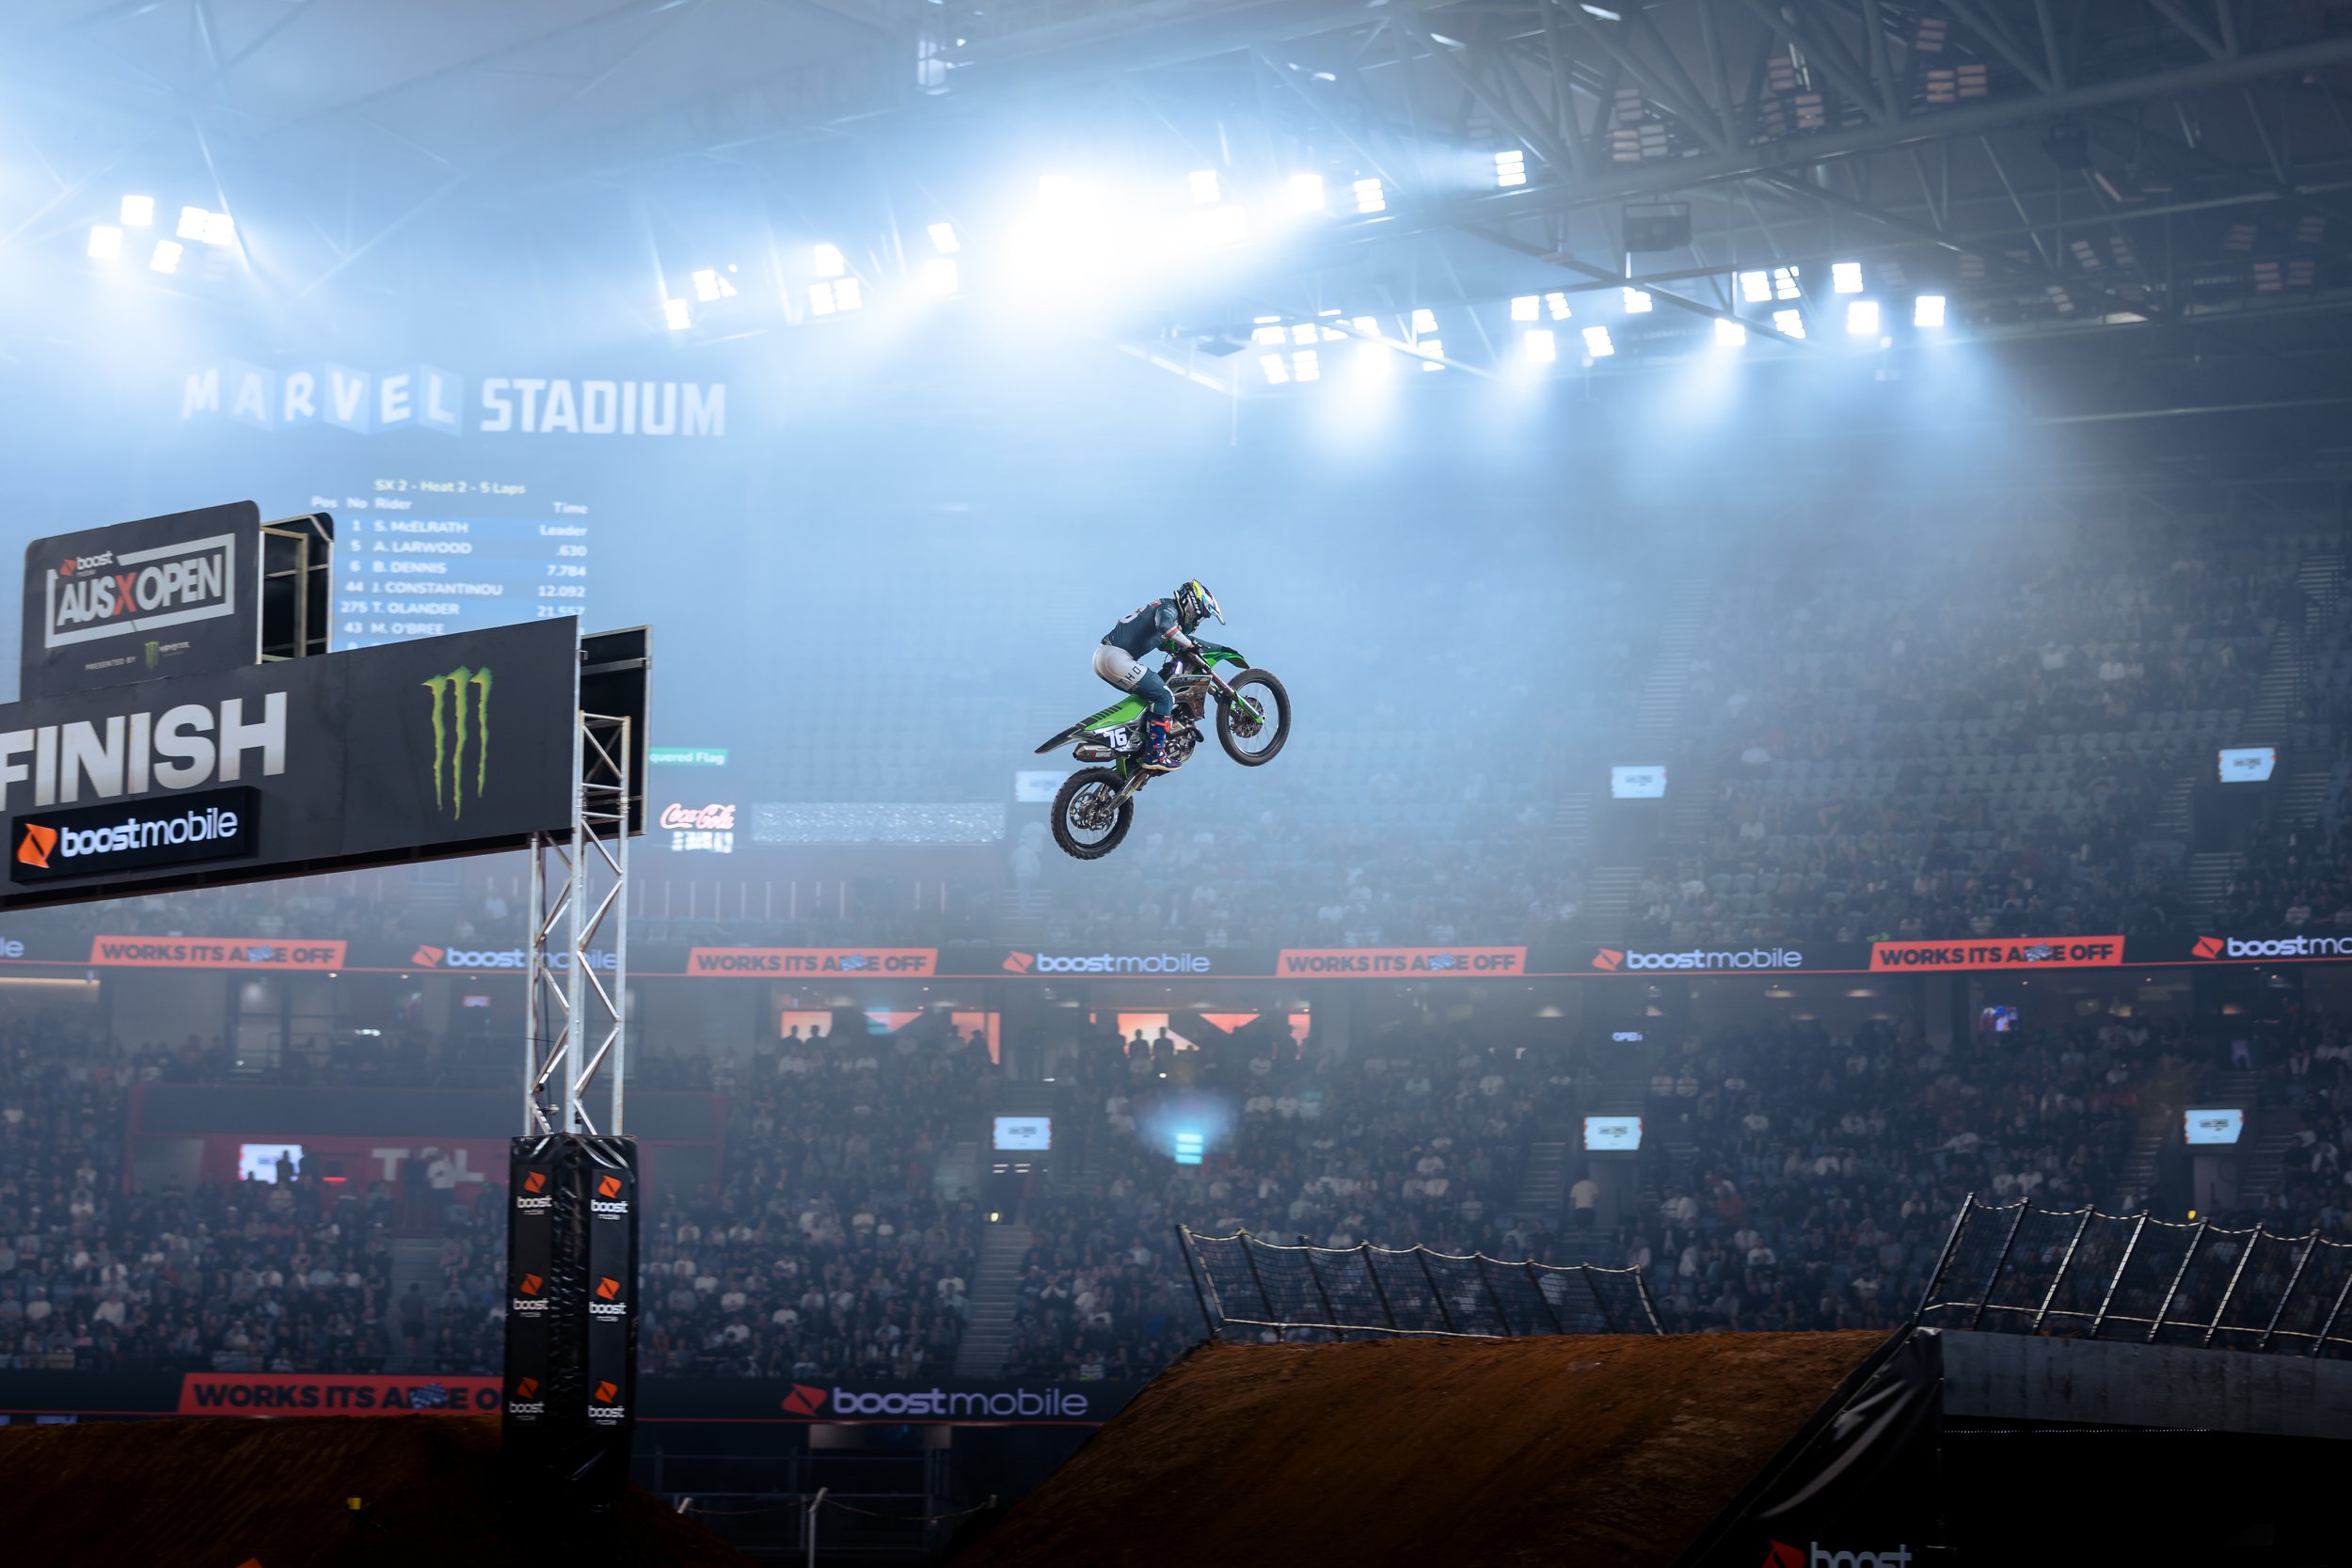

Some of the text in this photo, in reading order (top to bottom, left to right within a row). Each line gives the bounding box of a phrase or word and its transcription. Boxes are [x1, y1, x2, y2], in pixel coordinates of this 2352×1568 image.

[181, 368, 726, 436] MARVEL STADIUM
[374, 480, 395, 491] SX
[398, 481, 407, 492] 2
[421, 482, 454, 493] Heat
[457, 483, 467, 493] 2
[480, 483, 489, 494] 5
[493, 483, 526, 496] Laps
[311, 497, 588, 515] Pos No Rider Time
[352, 520, 360, 531] 1
[373, 520, 387, 532] S.
[540, 524, 588, 537] Leader
[351, 541, 361, 552] 5
[373, 541, 389, 552] A.
[391, 541, 472, 554] LARWOOD
[76, 550, 114, 570] boost
[350, 561, 360, 572] 6
[390, 562, 447, 574] DENNIS
[548, 565, 587, 577] 7.784
[345, 581, 364, 593] 44
[384, 582, 503, 596] CONSTANTINOU
[538, 586, 586, 597] 12.092
[341, 601, 368, 613] 275
[372, 601, 385, 613] T.
[388, 602, 460, 615] OLANDER
[344, 622, 444, 635] 43 M. O'BREE
[0, 691, 288, 812] FINISH
[696, 752, 724, 765] Flag
[61, 807, 238, 858] boostmobile
[101, 942, 186, 961] WORKS
[191, 944, 224, 961] ITS
[292, 947, 336, 964] OFF
[1627, 948, 1803, 970] boostmobile
[1880, 948, 1964, 966] WORKS
[1969, 946, 2002, 963] ITS
[2070, 944, 2113, 960] OFF
[697, 954, 784, 972] WORKS
[786, 955, 818, 972] ITS
[884, 955, 927, 972] OFF
[1037, 953, 1210, 973] boostmobile
[1286, 956, 1370, 973] WORKS
[1374, 956, 1406, 972] ITS
[1472, 954, 1516, 971] OFF
[516, 1196, 552, 1209] boost
[591, 1199, 628, 1213] boost
[514, 1297, 549, 1310] boost
[589, 1302, 627, 1315] boost
[193, 1384, 319, 1408] WORKS
[327, 1386, 375, 1409] ITS
[834, 1386, 1089, 1416] boostmobile
[509, 1401, 545, 1414] boost
[588, 1405, 626, 1418] boost
